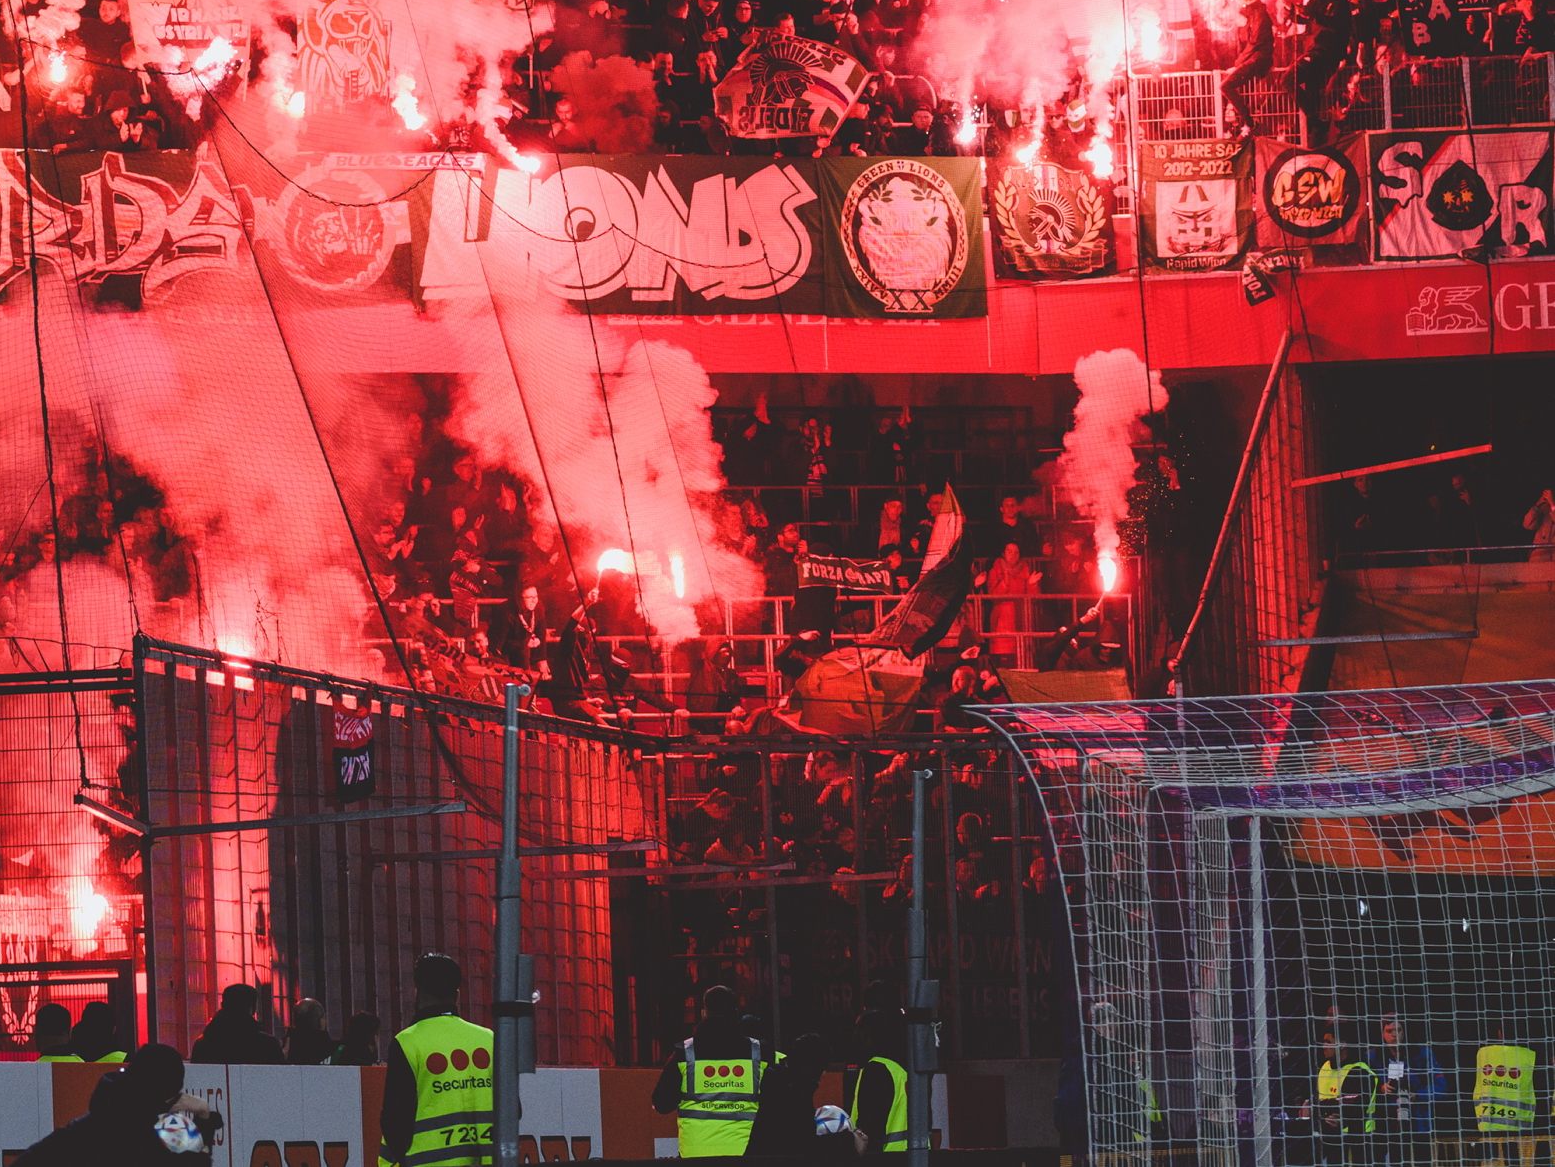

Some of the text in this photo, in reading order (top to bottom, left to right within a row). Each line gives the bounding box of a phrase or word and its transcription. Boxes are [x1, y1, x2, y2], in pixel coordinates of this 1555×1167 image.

[1153, 145, 1167, 158] 10
[1171, 144, 1212, 157] JAHRE
[404, 154, 474, 167] EAGLES
[857, 162, 946, 188] GREEN LIONS
[1164, 161, 1233, 176] 2012-2022
[1166, 258, 1198, 270] Rapid
[803, 562, 844, 581] FORZA
[432, 1075, 491, 1094] Securitas
[703, 1080, 745, 1088] Securitas
[1482, 1078, 1518, 1090] Securitas
[1482, 1105, 1517, 1118] 7349
